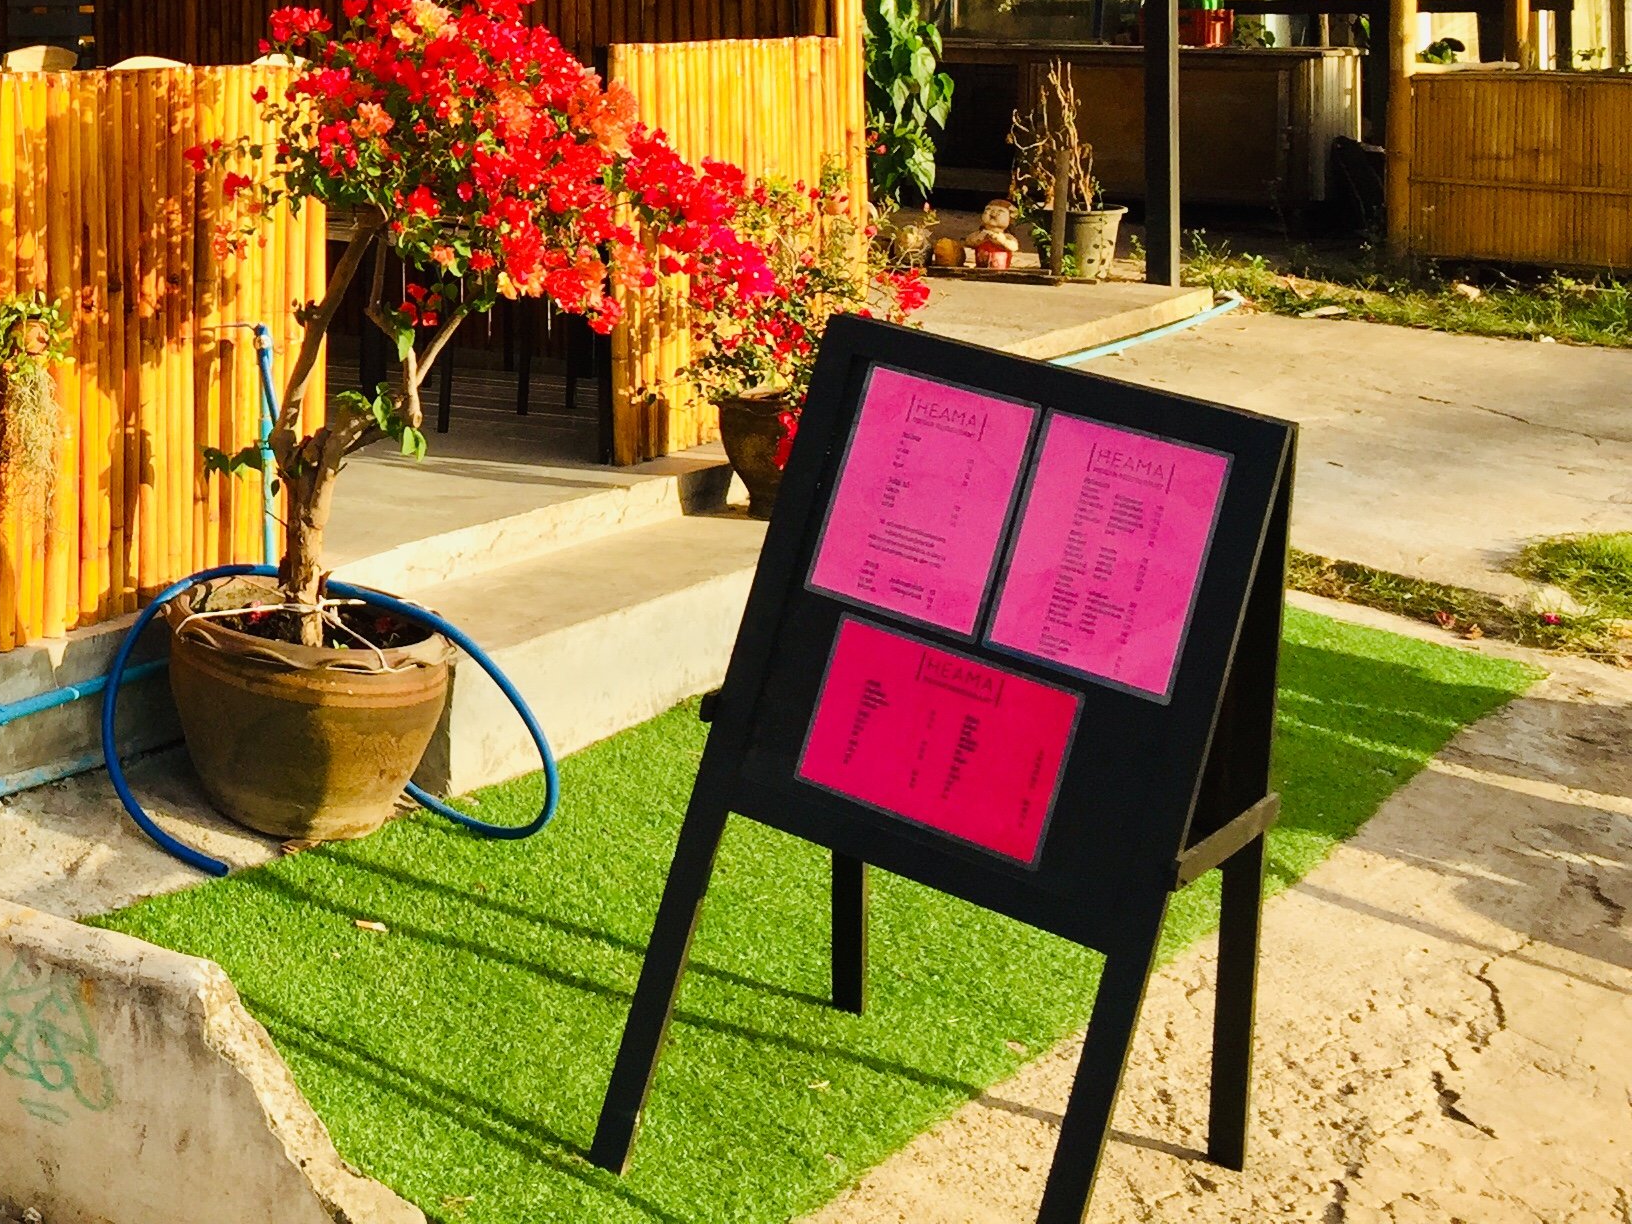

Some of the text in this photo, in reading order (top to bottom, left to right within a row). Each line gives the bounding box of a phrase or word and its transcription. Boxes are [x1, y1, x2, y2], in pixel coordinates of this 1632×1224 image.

[914, 398, 978, 427] HEAMA
[1096, 448, 1165, 479] HEAMA
[926, 657, 996, 694] HEAMA
